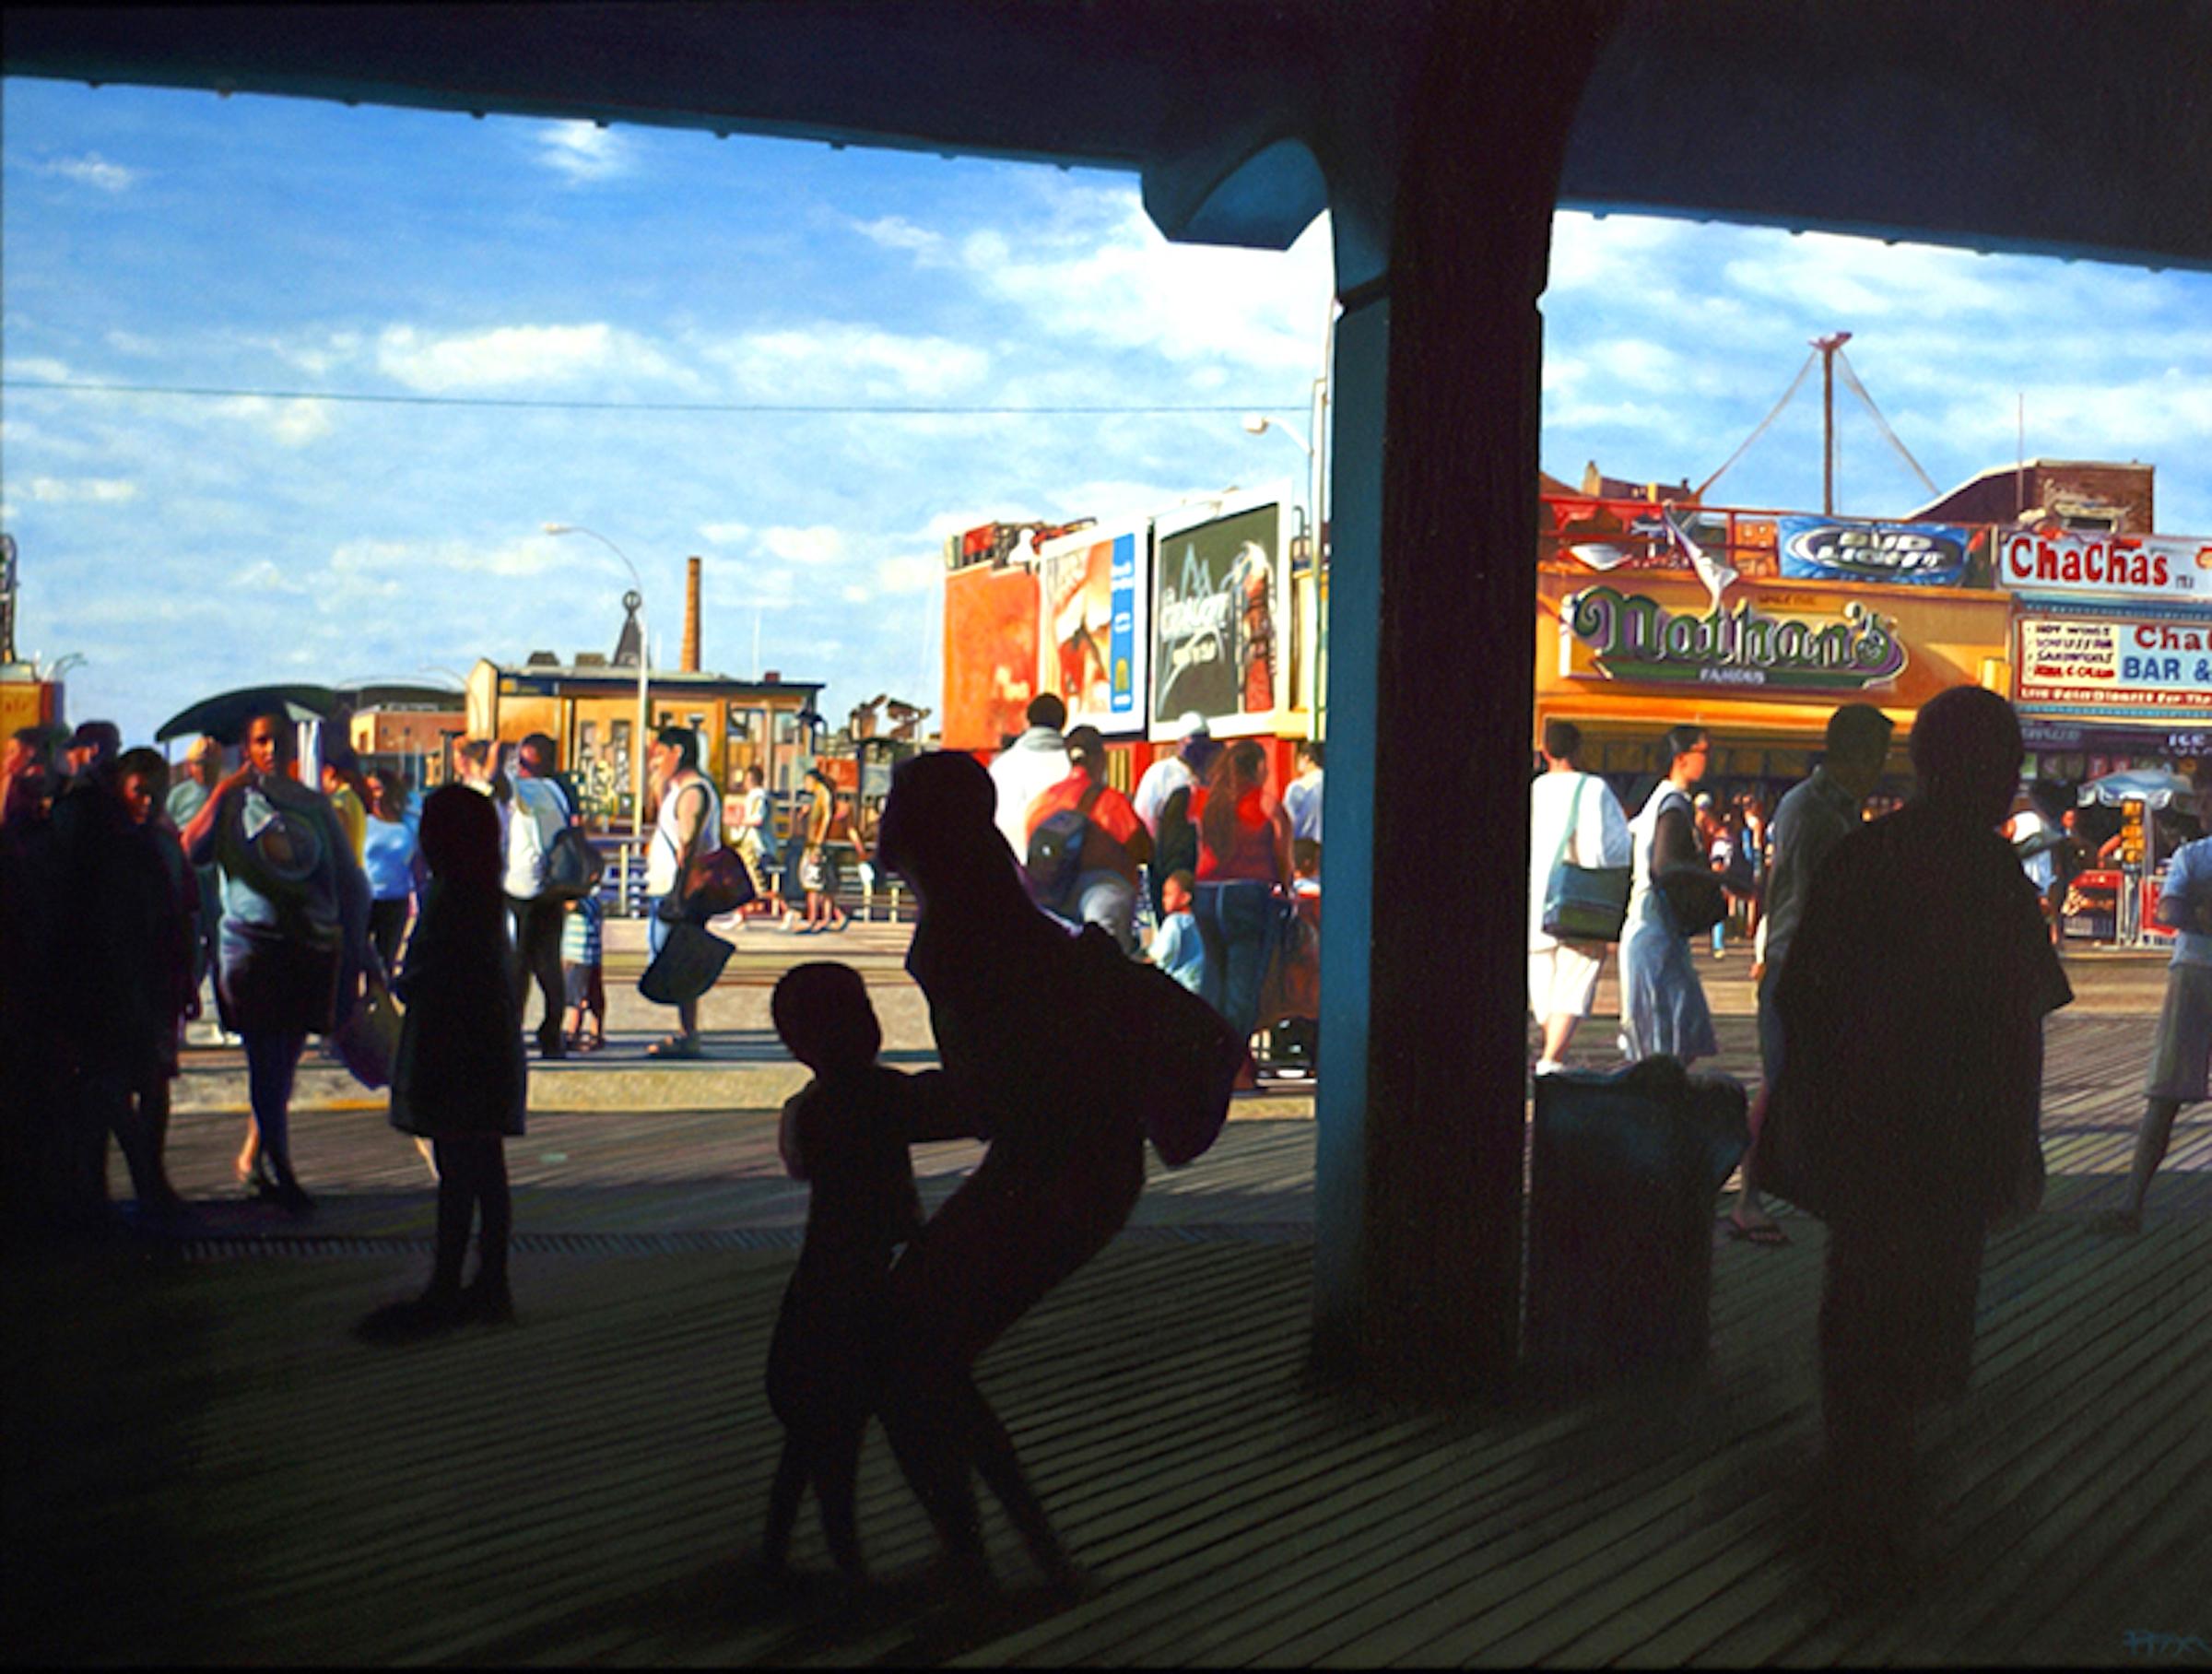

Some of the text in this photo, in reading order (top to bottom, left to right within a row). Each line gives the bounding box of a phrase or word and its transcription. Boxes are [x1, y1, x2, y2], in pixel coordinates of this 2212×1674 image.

[2008, 536, 2169, 586] ChaChas
[1572, 584, 1889, 669] Nathan's
[2123, 656, 2181, 681] BAR
